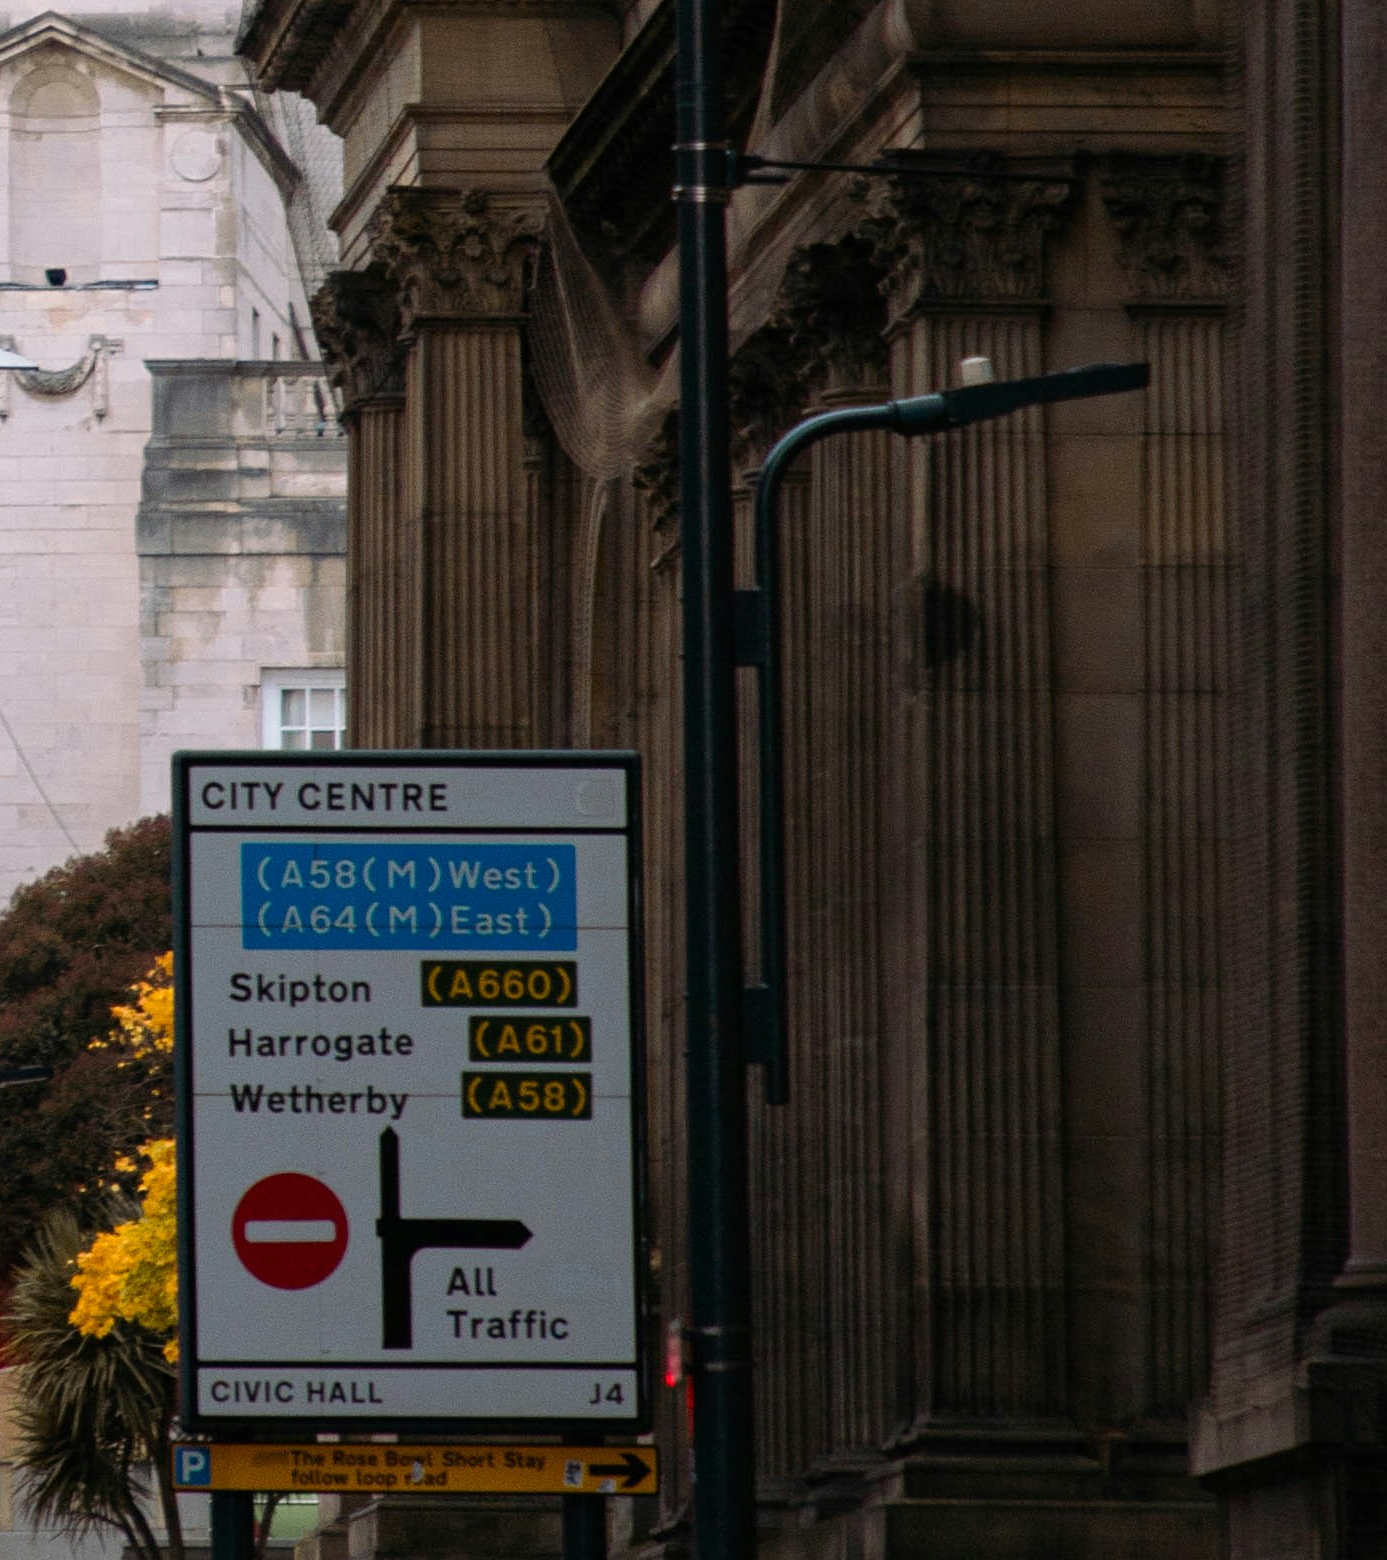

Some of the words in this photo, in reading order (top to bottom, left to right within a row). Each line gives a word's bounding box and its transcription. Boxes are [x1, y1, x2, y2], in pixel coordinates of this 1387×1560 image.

[201, 782, 283, 812] CITY
[297, 782, 447, 812] CENTRE
[229, 972, 370, 1008] Skipton
[427, 966, 571, 1003] (A660)
[228, 1027, 413, 1062] Harrogate
[475, 1022, 584, 1058] (A61)
[230, 1084, 409, 1121] Wetherby
[467, 1077, 586, 1115] (A58)
[446, 1267, 497, 1297] All
[446, 1309, 569, 1342] Traffic
[210, 1380, 294, 1404] CIVIC
[306, 1380, 383, 1404] HALL
[589, 1383, 625, 1406] J4
[182, 1451, 205, 1482] P
[290, 1449, 325, 1466] The
[332, 1450, 377, 1466] Rose
[442, 1451, 495, 1468] Short
[503, 1451, 545, 1471] Stay
[291, 1469, 349, 1486] follow
[357, 1469, 397, 1487] loop
[405, 1471, 447, 1486] rad
